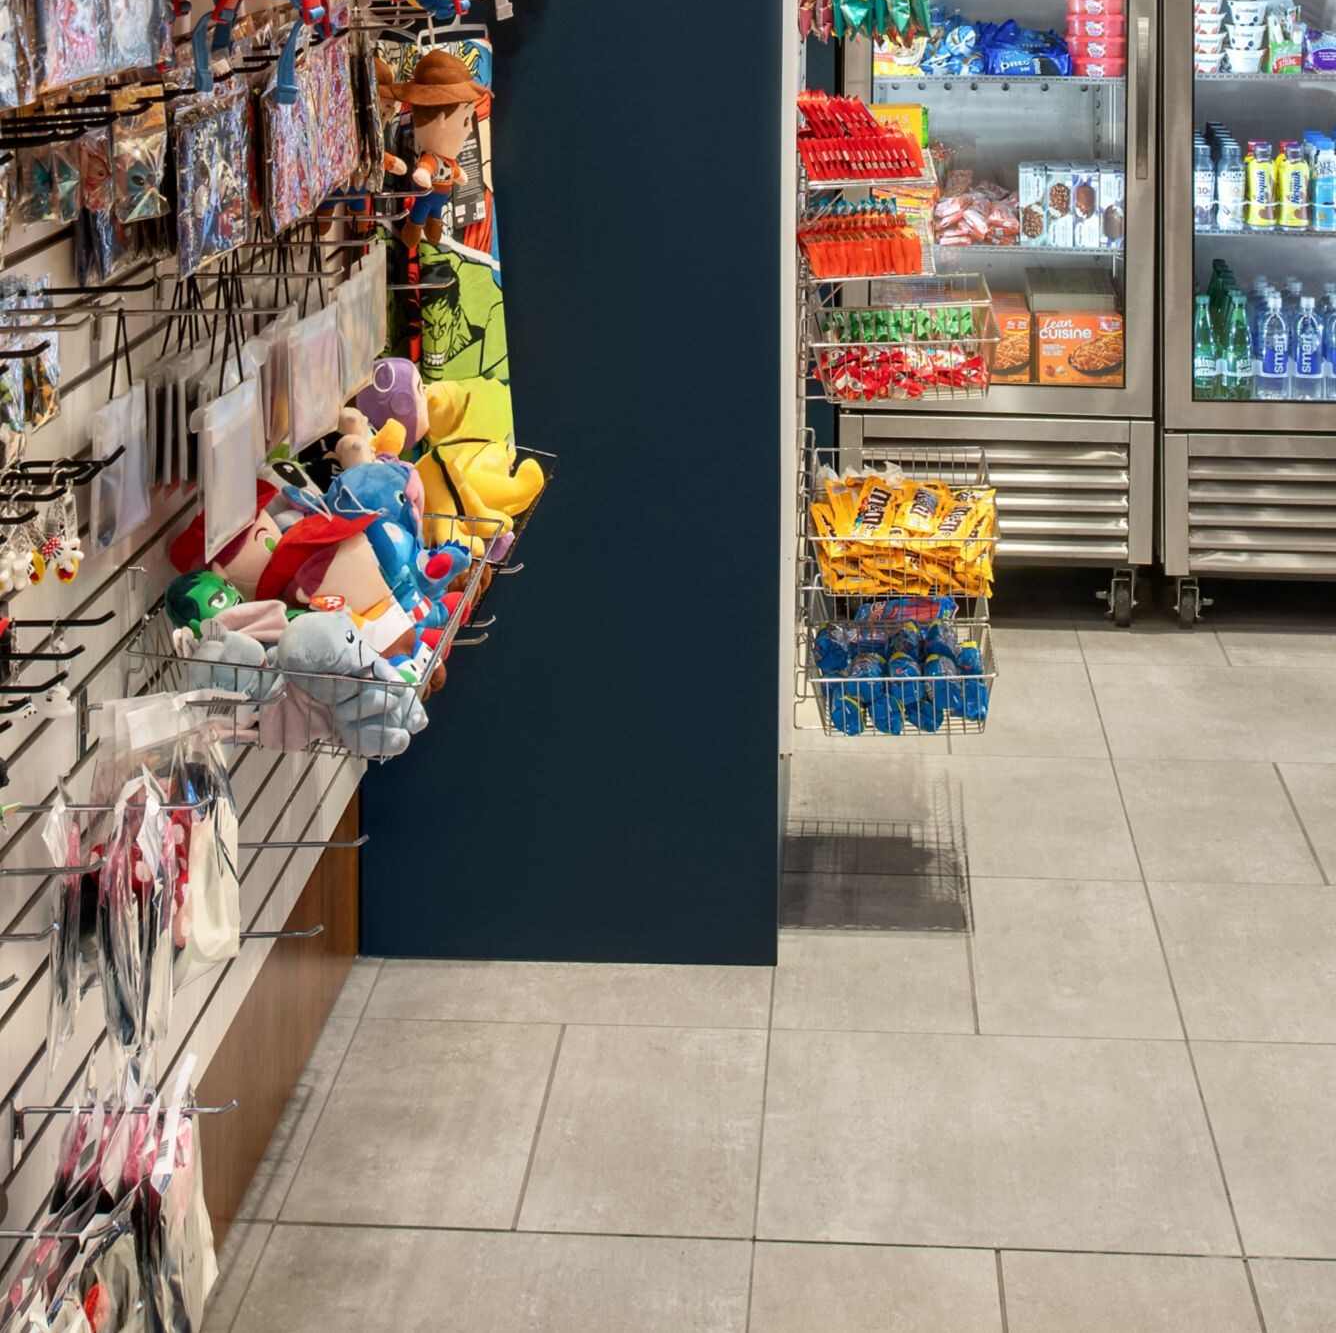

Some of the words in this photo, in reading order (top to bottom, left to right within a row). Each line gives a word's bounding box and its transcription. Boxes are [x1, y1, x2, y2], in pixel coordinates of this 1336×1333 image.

[1000, 59, 1030, 72] OREO
[1257, 170, 1267, 204] Nesquik
[1291, 170, 1302, 204] Nesquik
[1042, 318, 1075, 331] Lean
[1273, 333, 1284, 373] smart
[1301, 333, 1312, 373] smart
